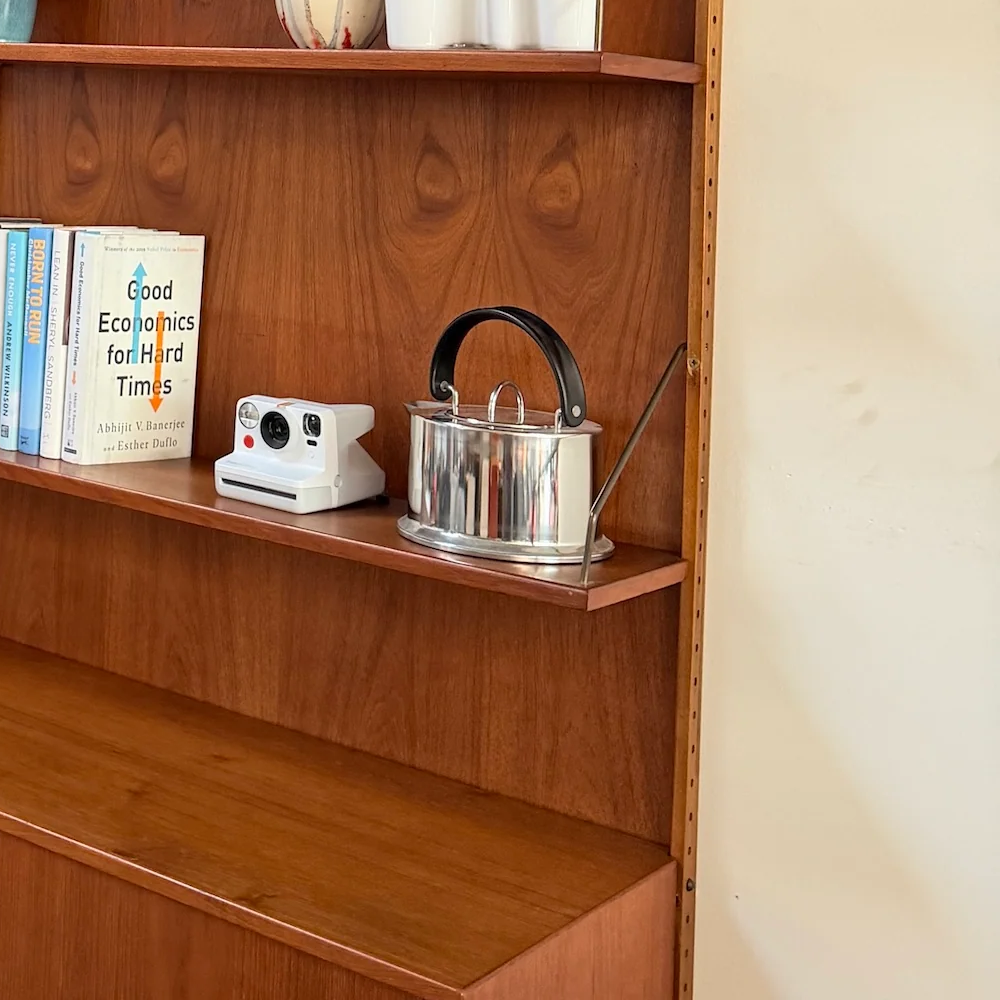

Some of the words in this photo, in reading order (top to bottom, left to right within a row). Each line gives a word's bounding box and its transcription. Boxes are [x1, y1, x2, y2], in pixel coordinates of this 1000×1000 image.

[31, 239, 46, 284] BORN
[8, 276, 16, 317] ENOUGH
[30, 286, 43, 307] TO
[52, 284, 59, 296] IN
[75, 280, 84, 315] Economics
[127, 279, 173, 300] Good
[28, 309, 41, 344] RUN
[48, 306, 58, 349] SHERYL
[98, 310, 195, 333] Economics
[5, 321, 13, 361] ANDREW
[107, 344, 133, 365] for
[141, 342, 184, 364] Hard
[2, 365, 11, 417] WILKINSON
[44, 355, 55, 420] SANDBERG
[116, 375, 172, 396] Times
[97, 423, 132, 435] Abhijit
[136, 421, 143, 431] V.
[146, 420, 185, 431] Banerjee
[117, 440, 149, 451] Esther
[152, 437, 178, 448] Duflo
